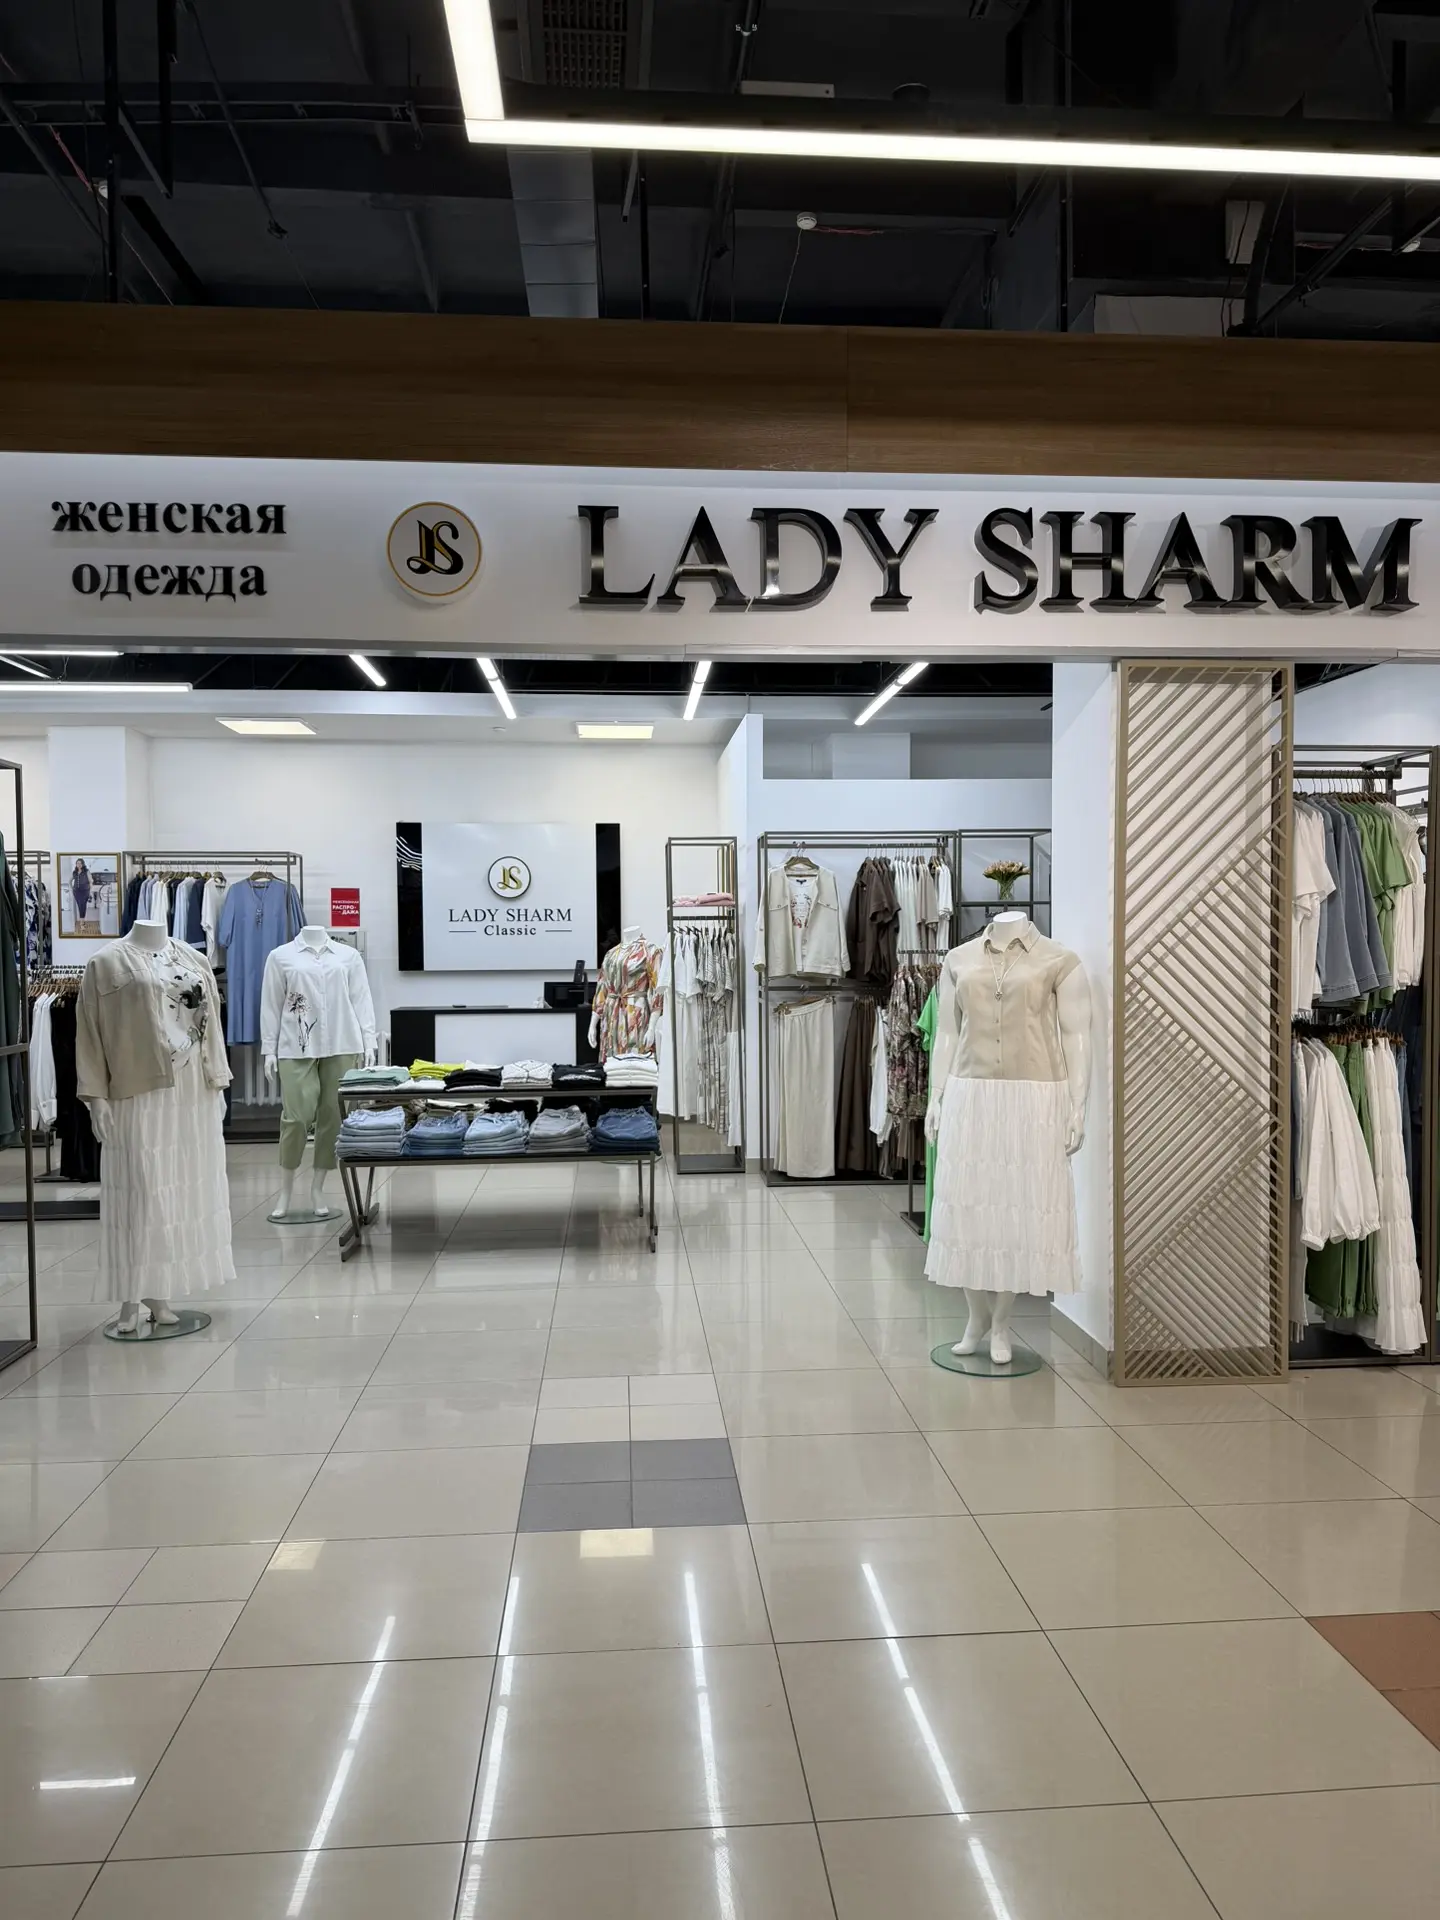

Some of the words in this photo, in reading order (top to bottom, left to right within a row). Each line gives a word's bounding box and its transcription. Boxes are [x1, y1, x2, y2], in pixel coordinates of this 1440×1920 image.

[51, 501, 287, 534] женская
[577, 505, 940, 606] LADY
[973, 507, 1423, 614] SHARM
[72, 563, 268, 602] одежда
[448, 908, 499, 923] LADY
[506, 908, 572, 922] SHARM
[484, 924, 537, 936] Classic
